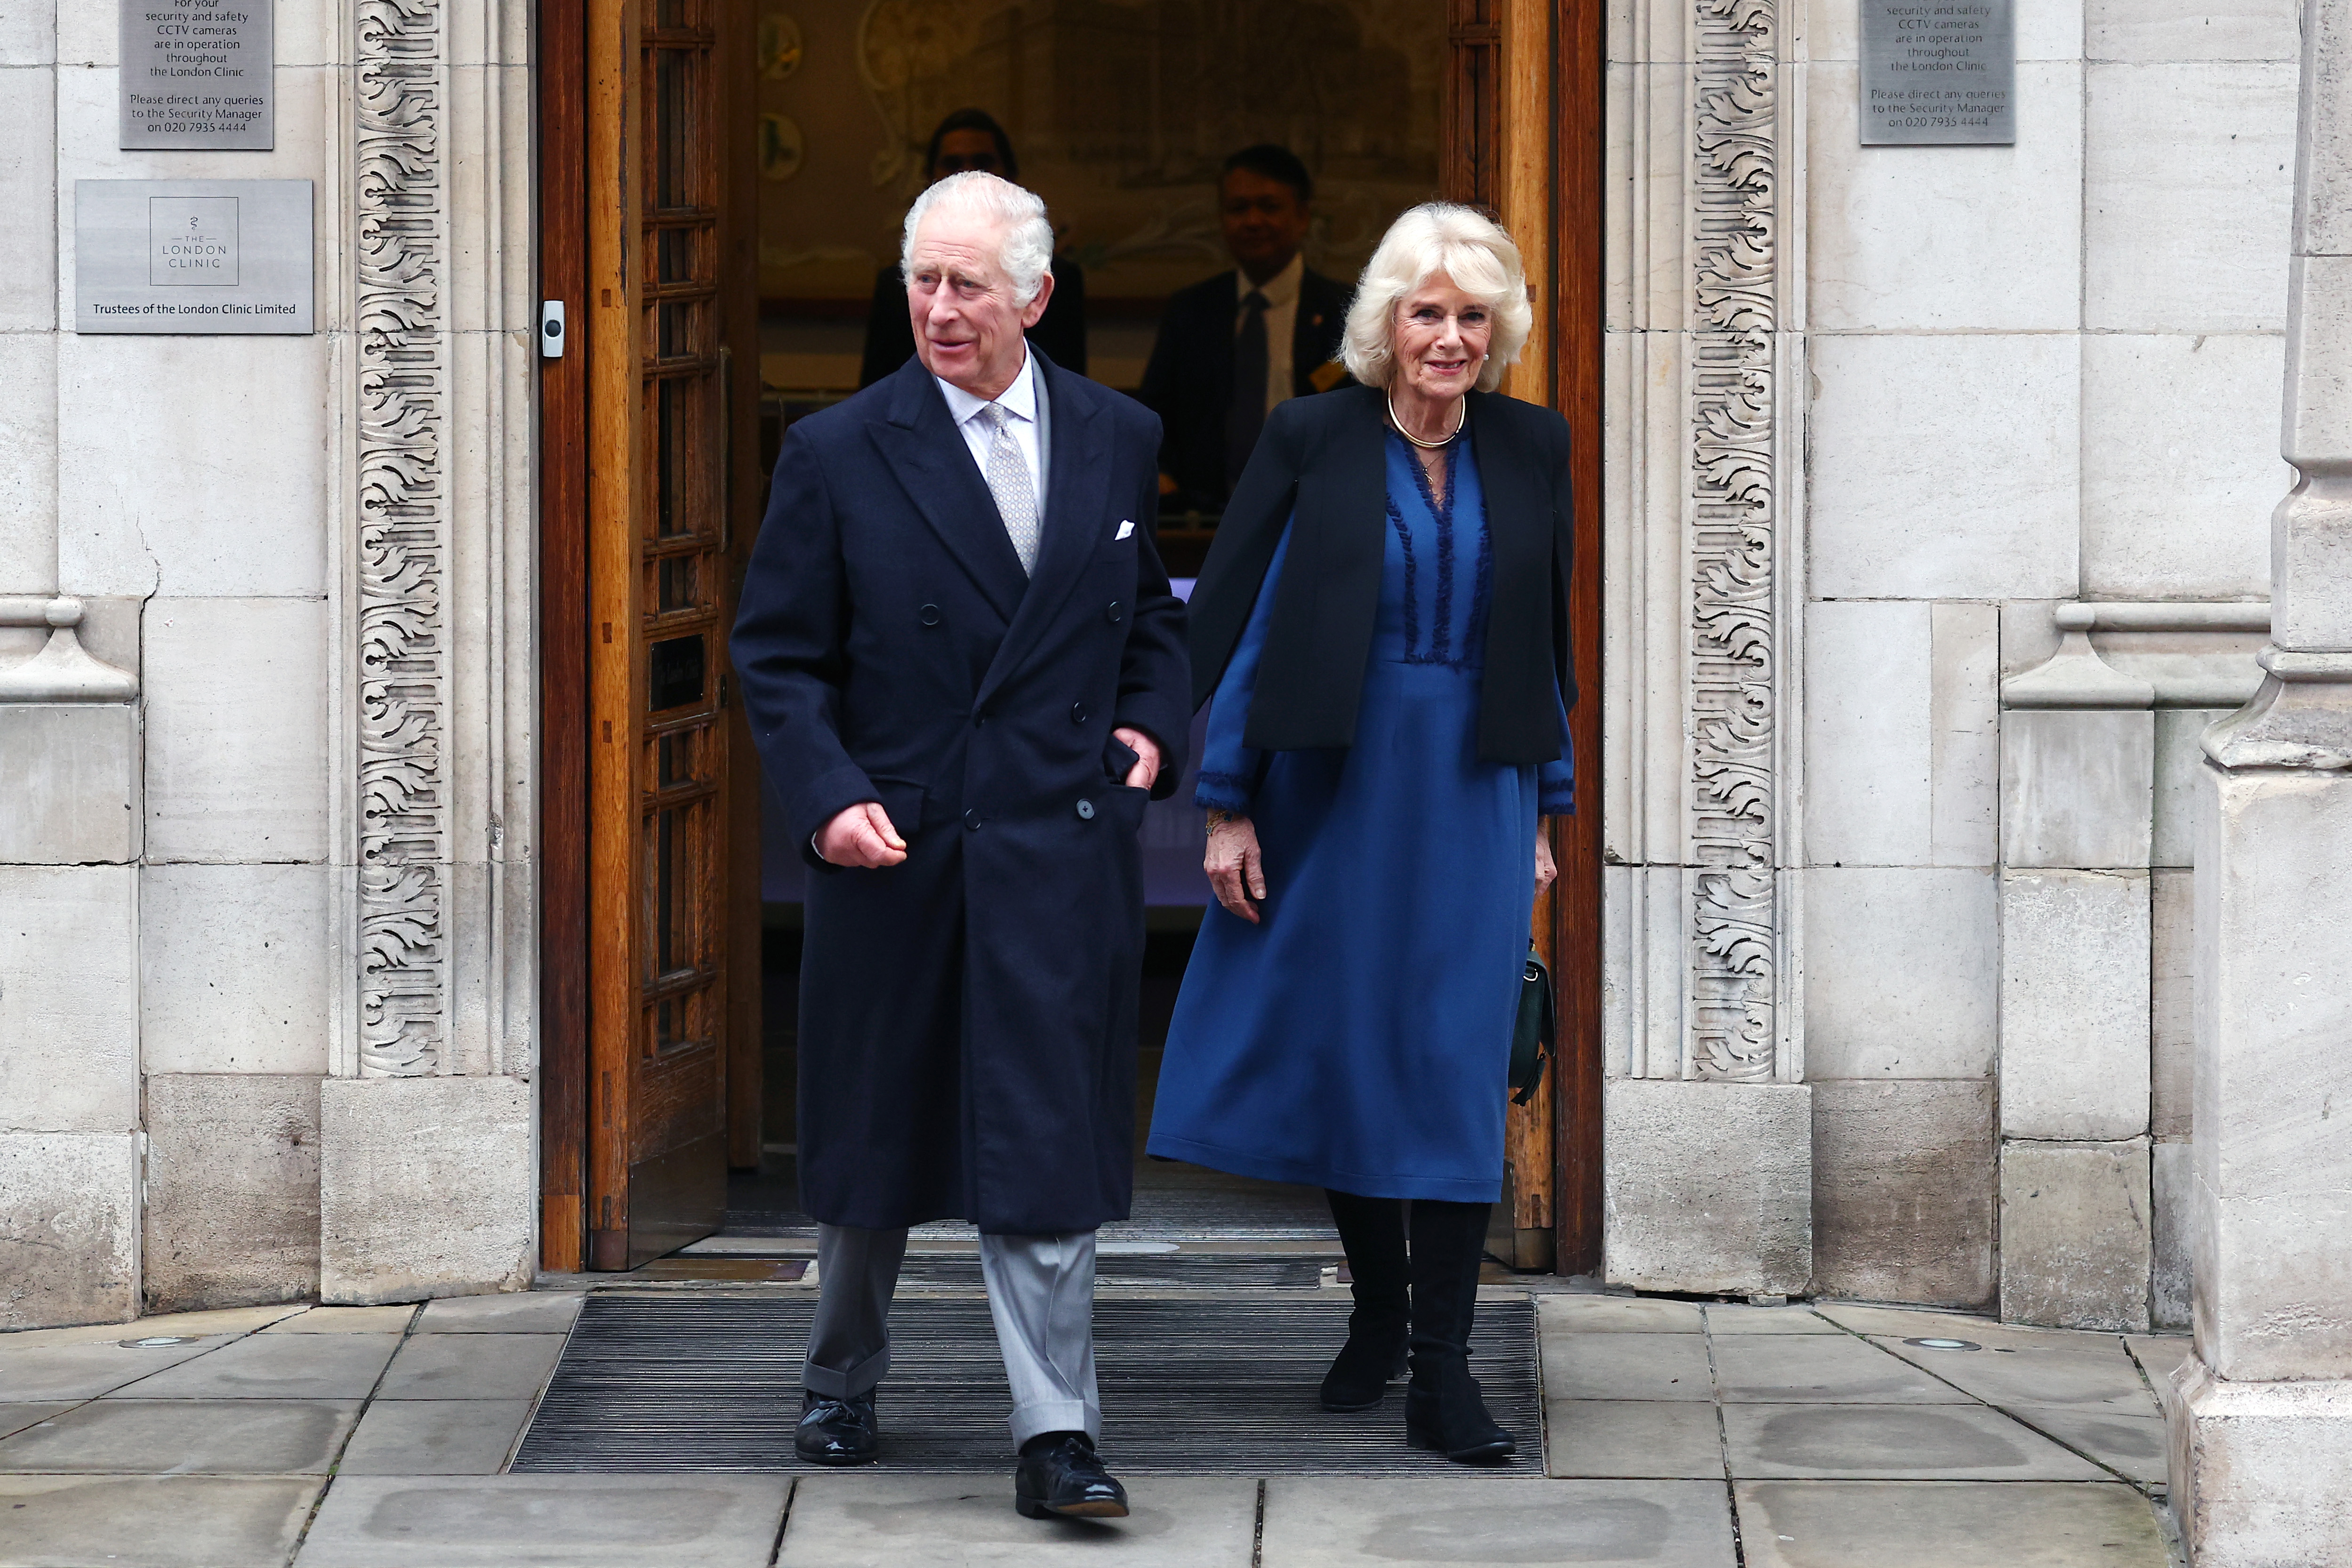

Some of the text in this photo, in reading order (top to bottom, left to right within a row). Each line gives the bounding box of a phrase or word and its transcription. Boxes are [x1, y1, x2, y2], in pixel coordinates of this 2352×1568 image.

[195, 0, 218, 9] your
[1887, 5, 1991, 17] security and safety
[146, 12, 248, 23] security and safety
[1899, 19, 1979, 29] CCTV cameras
[157, 25, 237, 35] CCTV cameras
[1916, 34, 1925, 42] in
[1928, 34, 1982, 45] operation
[174, 39, 183, 48] in
[187, 39, 240, 51] operation
[1908, 48, 1969, 59] throughout
[167, 53, 227, 65] throughout
[1891, 61, 1986, 71] the London Clinic
[150, 67, 244, 77] the London Clinic
[1871, 89, 2006, 101] Please direct any queries
[130, 94, 263, 108] Please direct any queries
[1873, 103, 2004, 115] to the Security Manager
[132, 109, 262, 121] to the Security Manager
[1906, 117, 1927, 127] 020
[1931, 117, 1957, 127] 7935
[165, 123, 185, 132] 020
[190, 123, 215, 132] 7935
[218, 123, 246, 132] 4444
[163, 246, 226, 254] LONDON
[169, 259, 220, 267] CLINIC
[93, 304, 296, 314] Trustees of the London Clinic Limited
